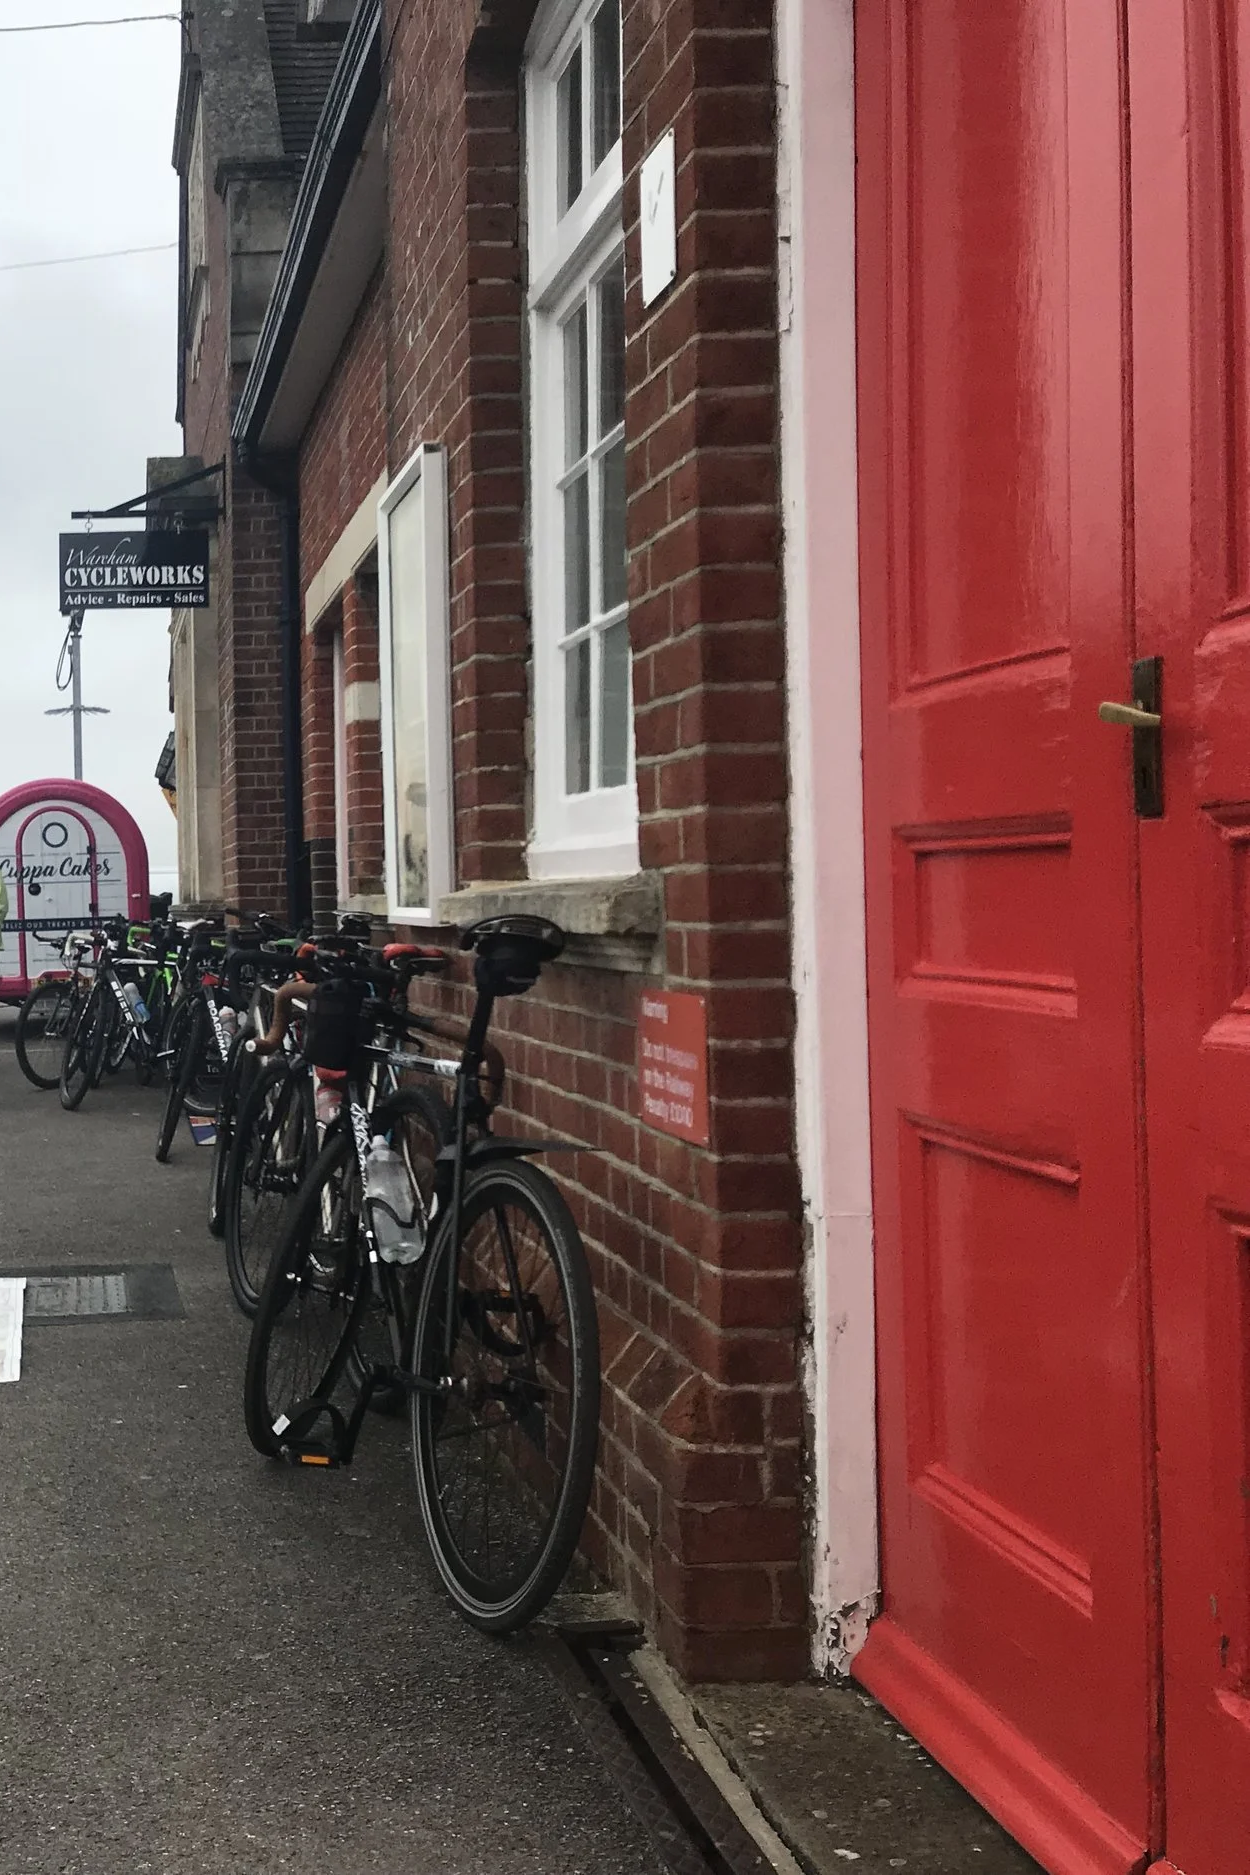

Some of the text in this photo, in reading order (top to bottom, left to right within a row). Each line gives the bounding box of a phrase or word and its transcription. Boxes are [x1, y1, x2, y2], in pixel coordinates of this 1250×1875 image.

[66, 537, 138, 566] Wareham
[64, 565, 205, 588] CYCLEWORKS
[64, 591, 205, 606] Advice Repairs Sales
[59, 856, 111, 877] Cakes
